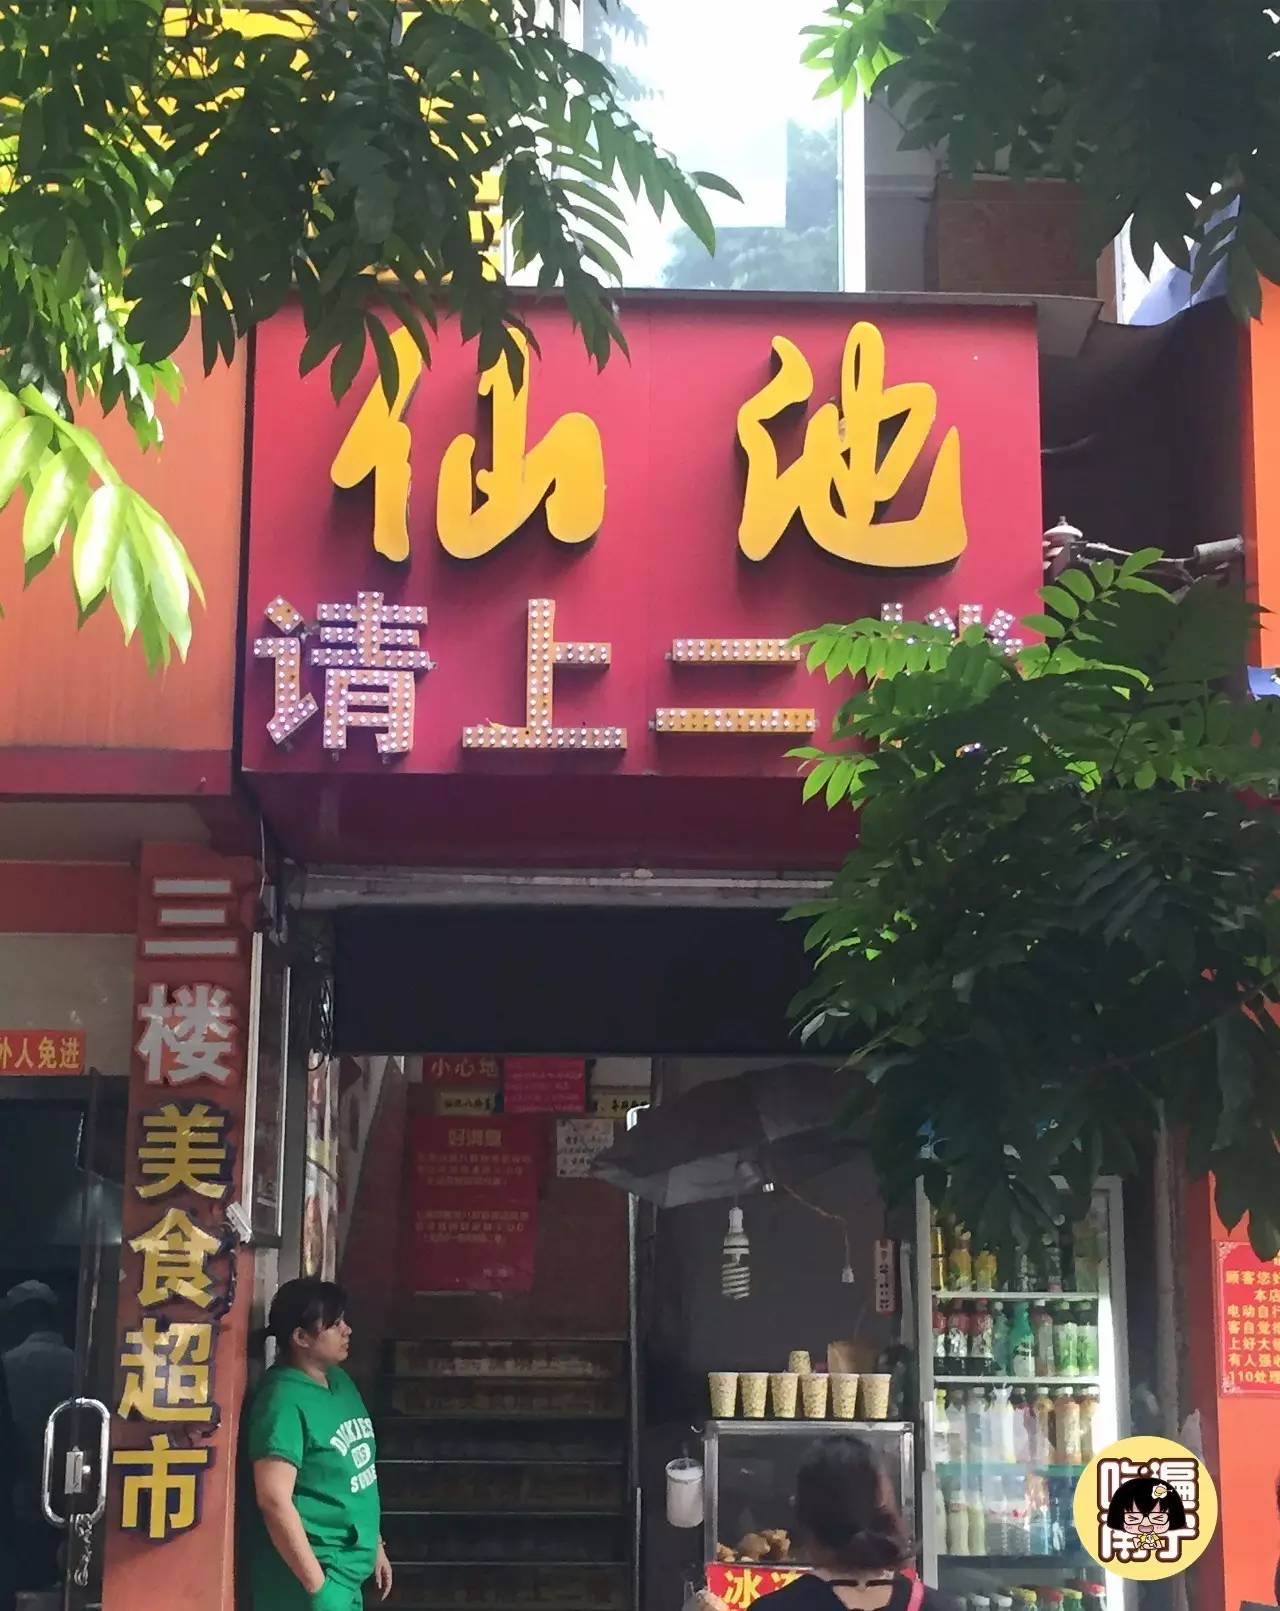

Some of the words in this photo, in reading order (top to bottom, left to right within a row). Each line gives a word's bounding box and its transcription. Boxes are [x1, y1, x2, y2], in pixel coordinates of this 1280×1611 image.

[331, 321, 967, 568] 仙池
[254, 591, 1023, 754] 请上二
[113, 879, 238, 1539] 三楼美食超市
